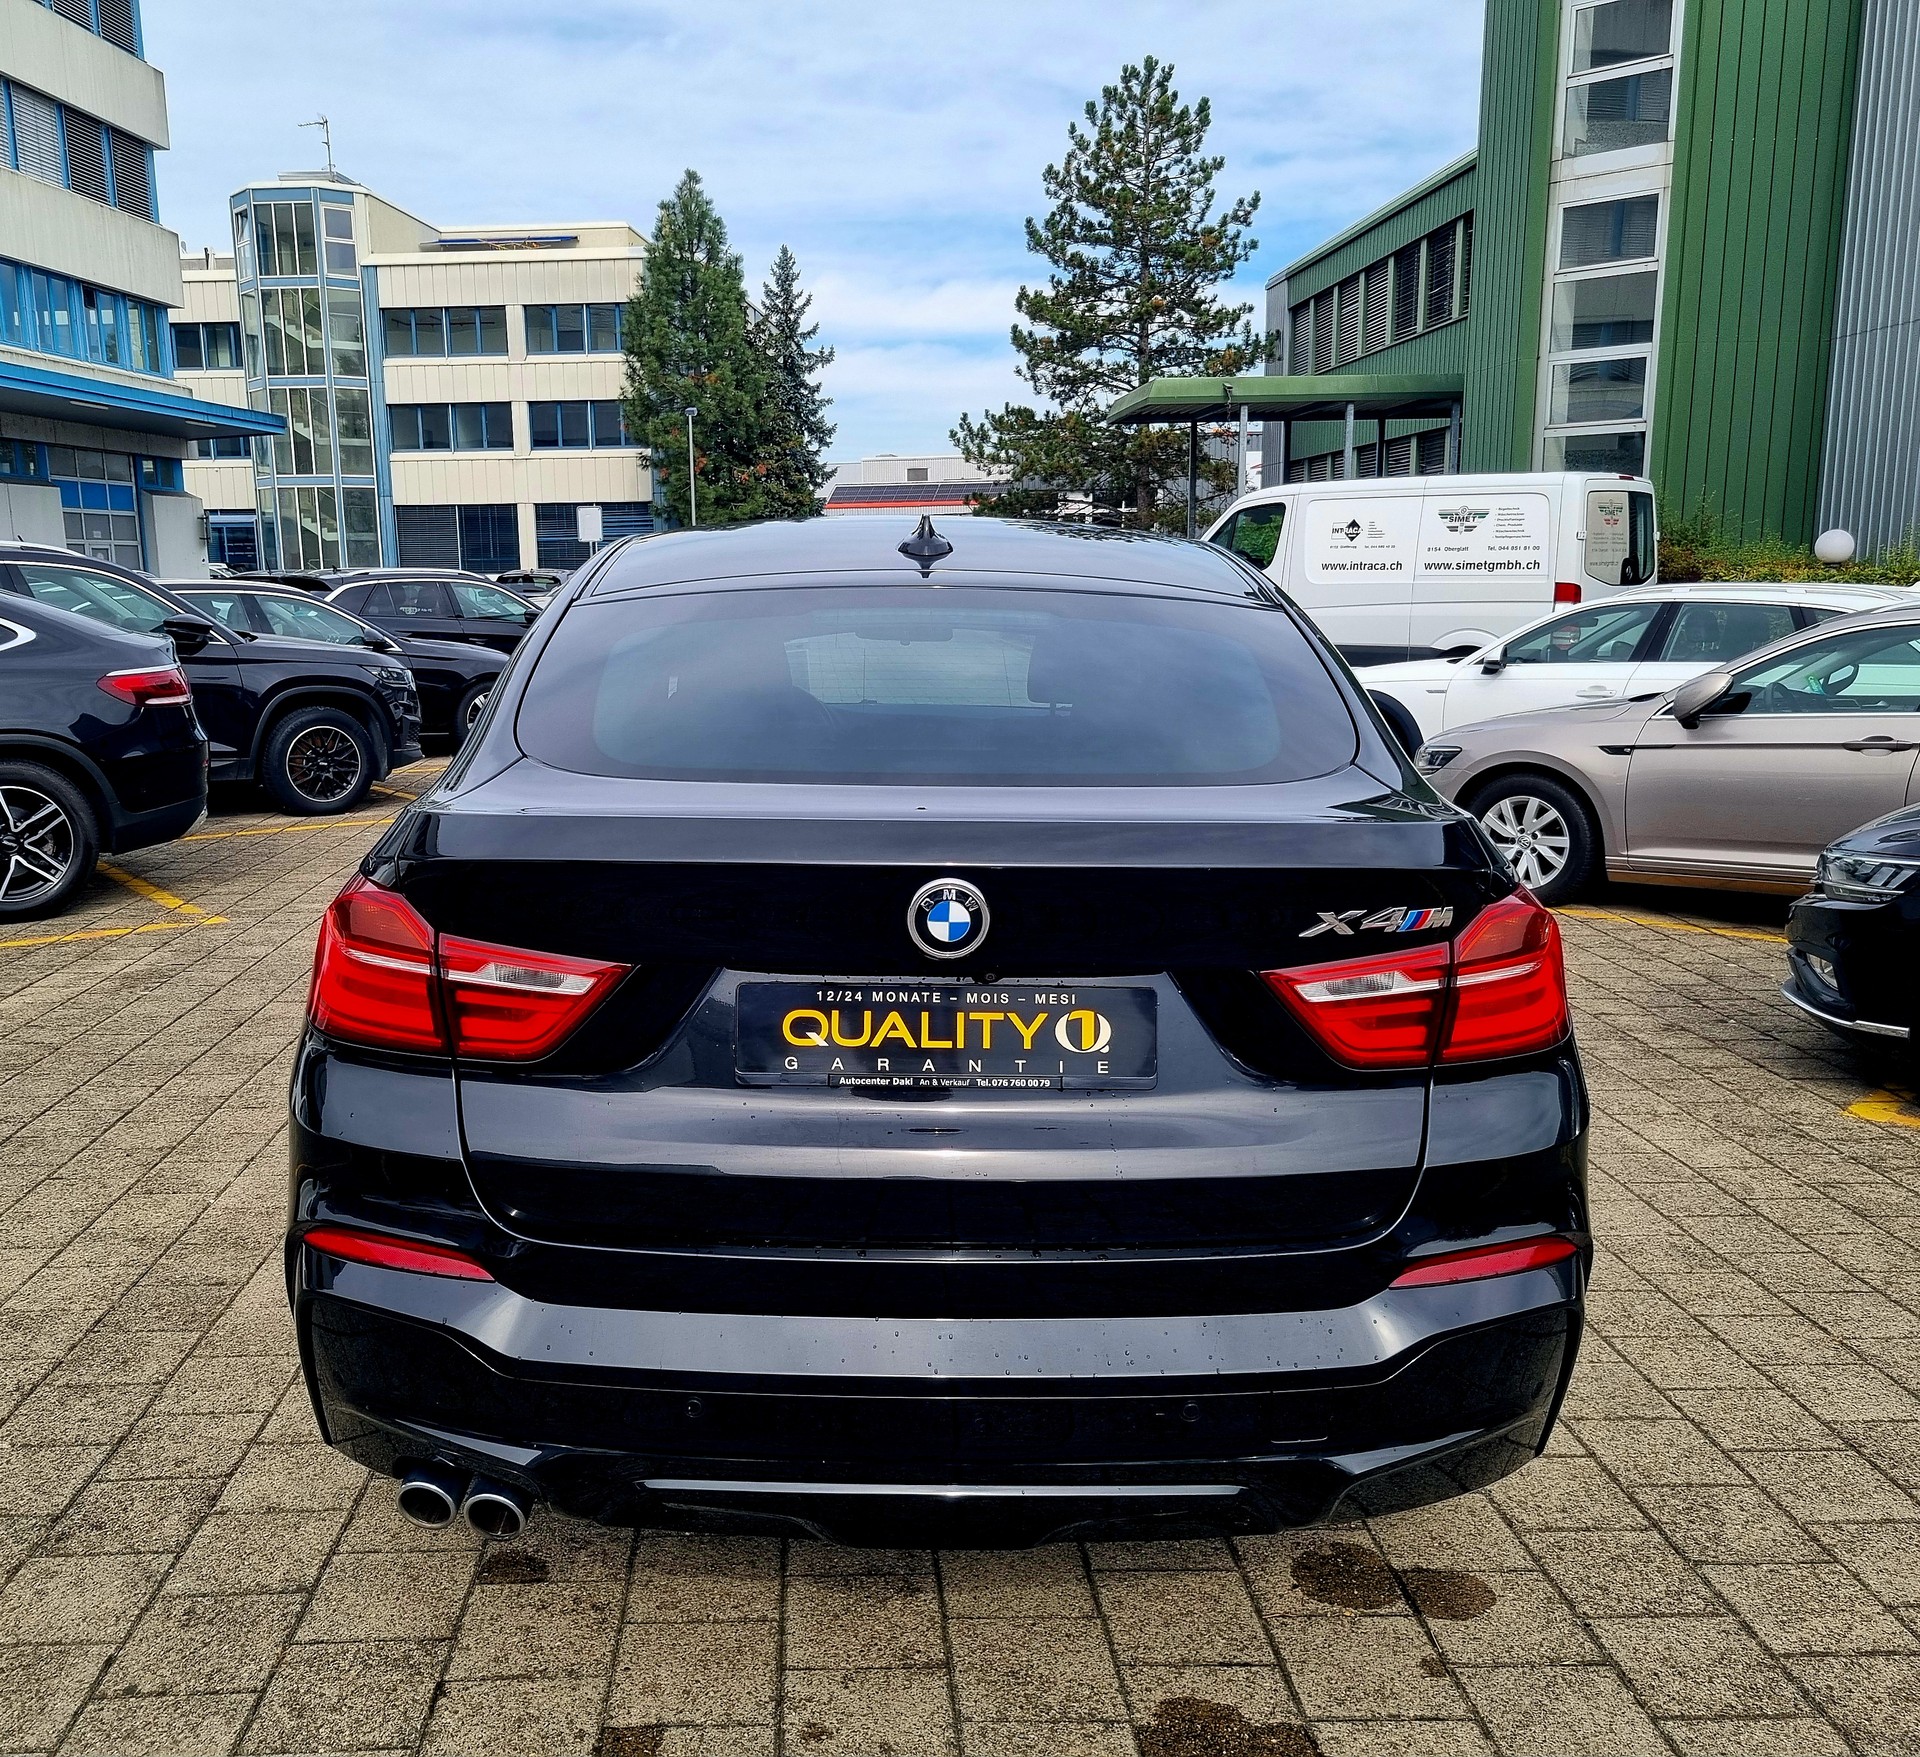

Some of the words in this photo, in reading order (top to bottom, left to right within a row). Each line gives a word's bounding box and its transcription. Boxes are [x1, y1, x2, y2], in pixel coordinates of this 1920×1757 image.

[1448, 515, 1478, 523] SIMET
[1321, 560, 1403, 571] www.intraca.ch
[1424, 560, 1541, 572] www.simetgmbh.ch
[920, 888, 979, 912] BMW
[816, 990, 863, 1002] 12/24
[872, 991, 941, 1003] MONATE
[966, 993, 1009, 1004] MOIS
[1035, 993, 1076, 1005] MESI
[782, 1009, 1048, 1050] QUALITY
[784, 1056, 1109, 1074] GARANTIE
[839, 1076, 890, 1086] Autocenter
[892, 1077, 913, 1086] Daki
[940, 1079, 970, 1087] Verkauf
